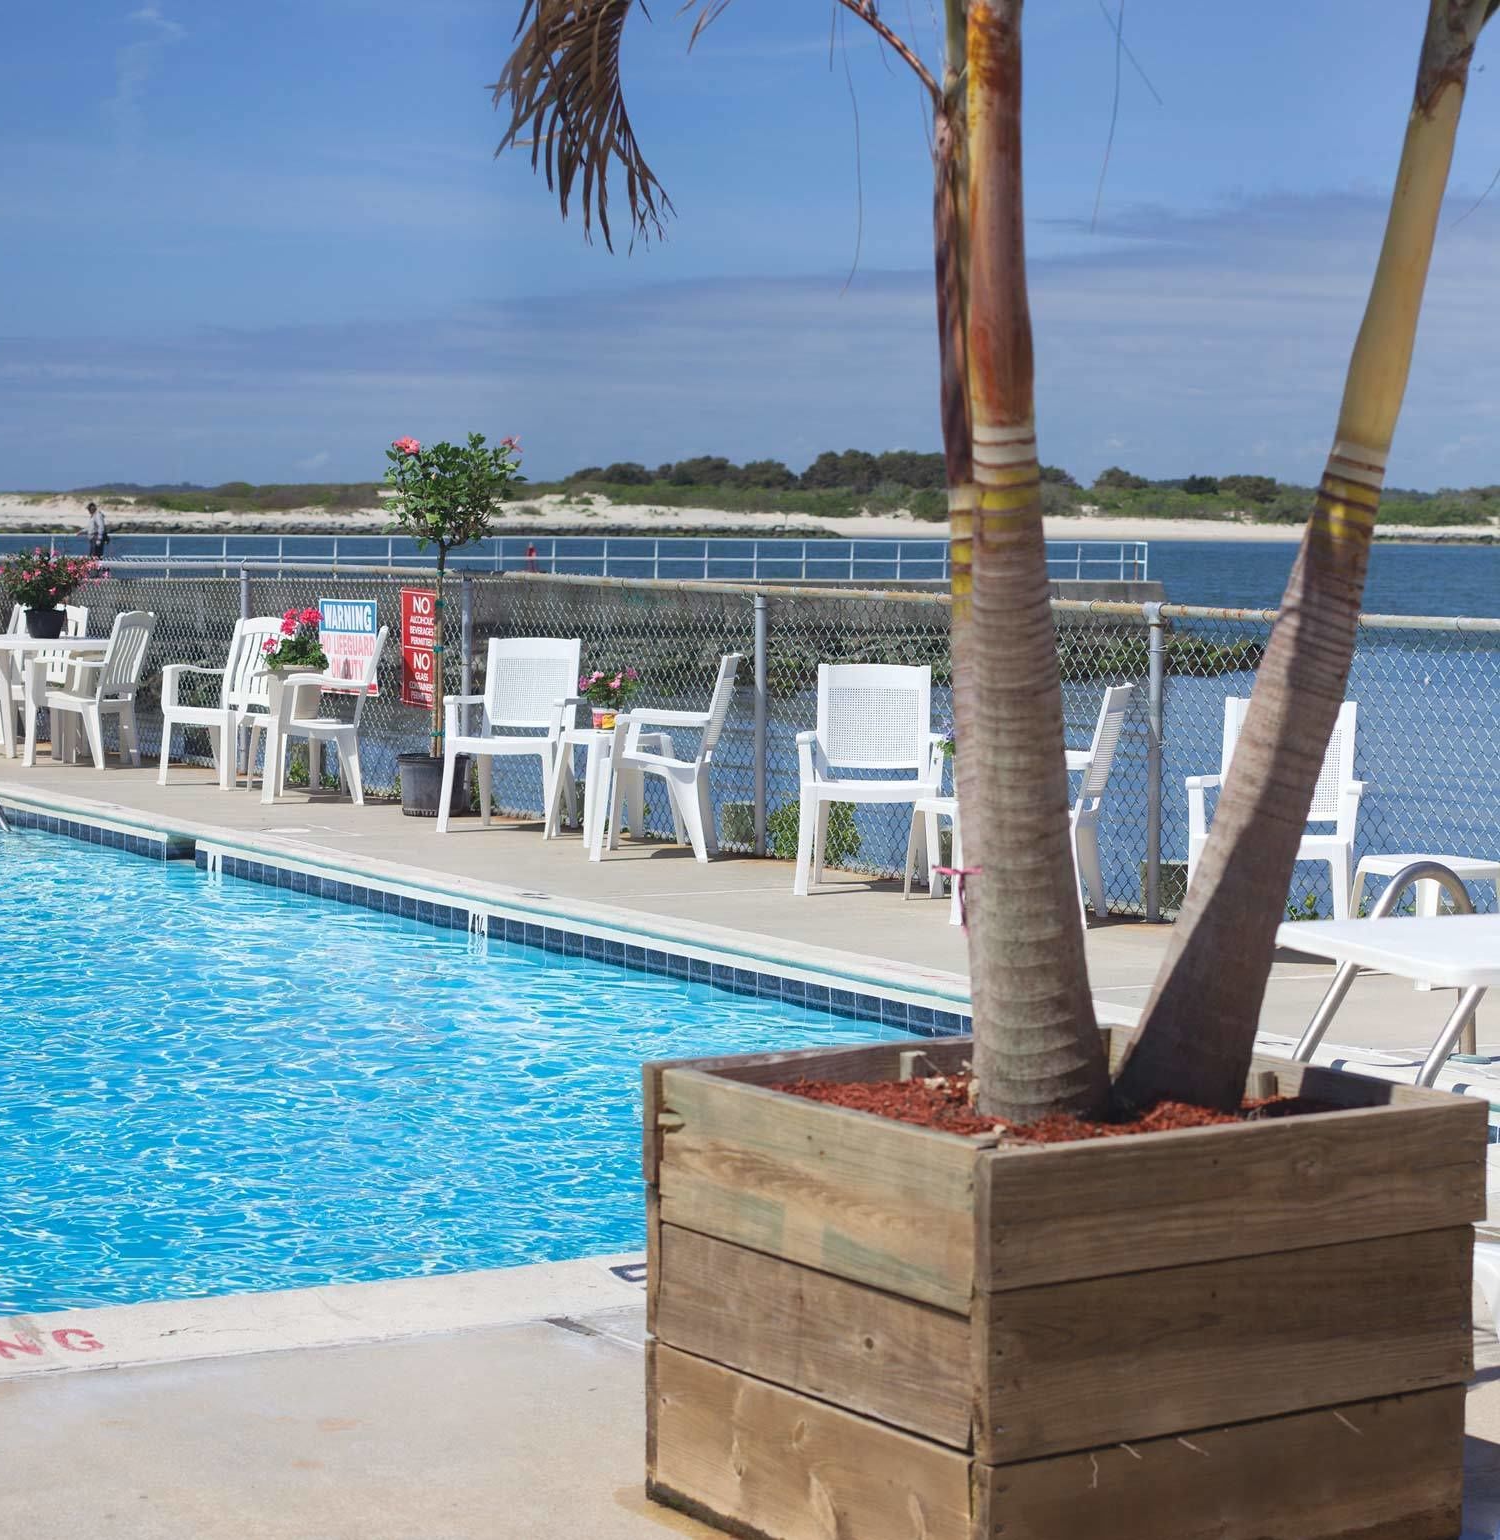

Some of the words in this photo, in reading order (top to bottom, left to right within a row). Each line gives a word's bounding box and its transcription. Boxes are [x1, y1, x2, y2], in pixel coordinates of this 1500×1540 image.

[413, 596, 430, 614] NO
[323, 604, 372, 632] WARNING
[410, 626, 434, 636] BEVERAGES
[321, 633, 332, 655] NO
[334, 634, 374, 656] LIFEGUARD
[410, 636, 433, 647] PERMITTED
[332, 657, 341, 679] ON
[413, 652, 430, 671] NO
[414, 671, 429, 682] GLASS
